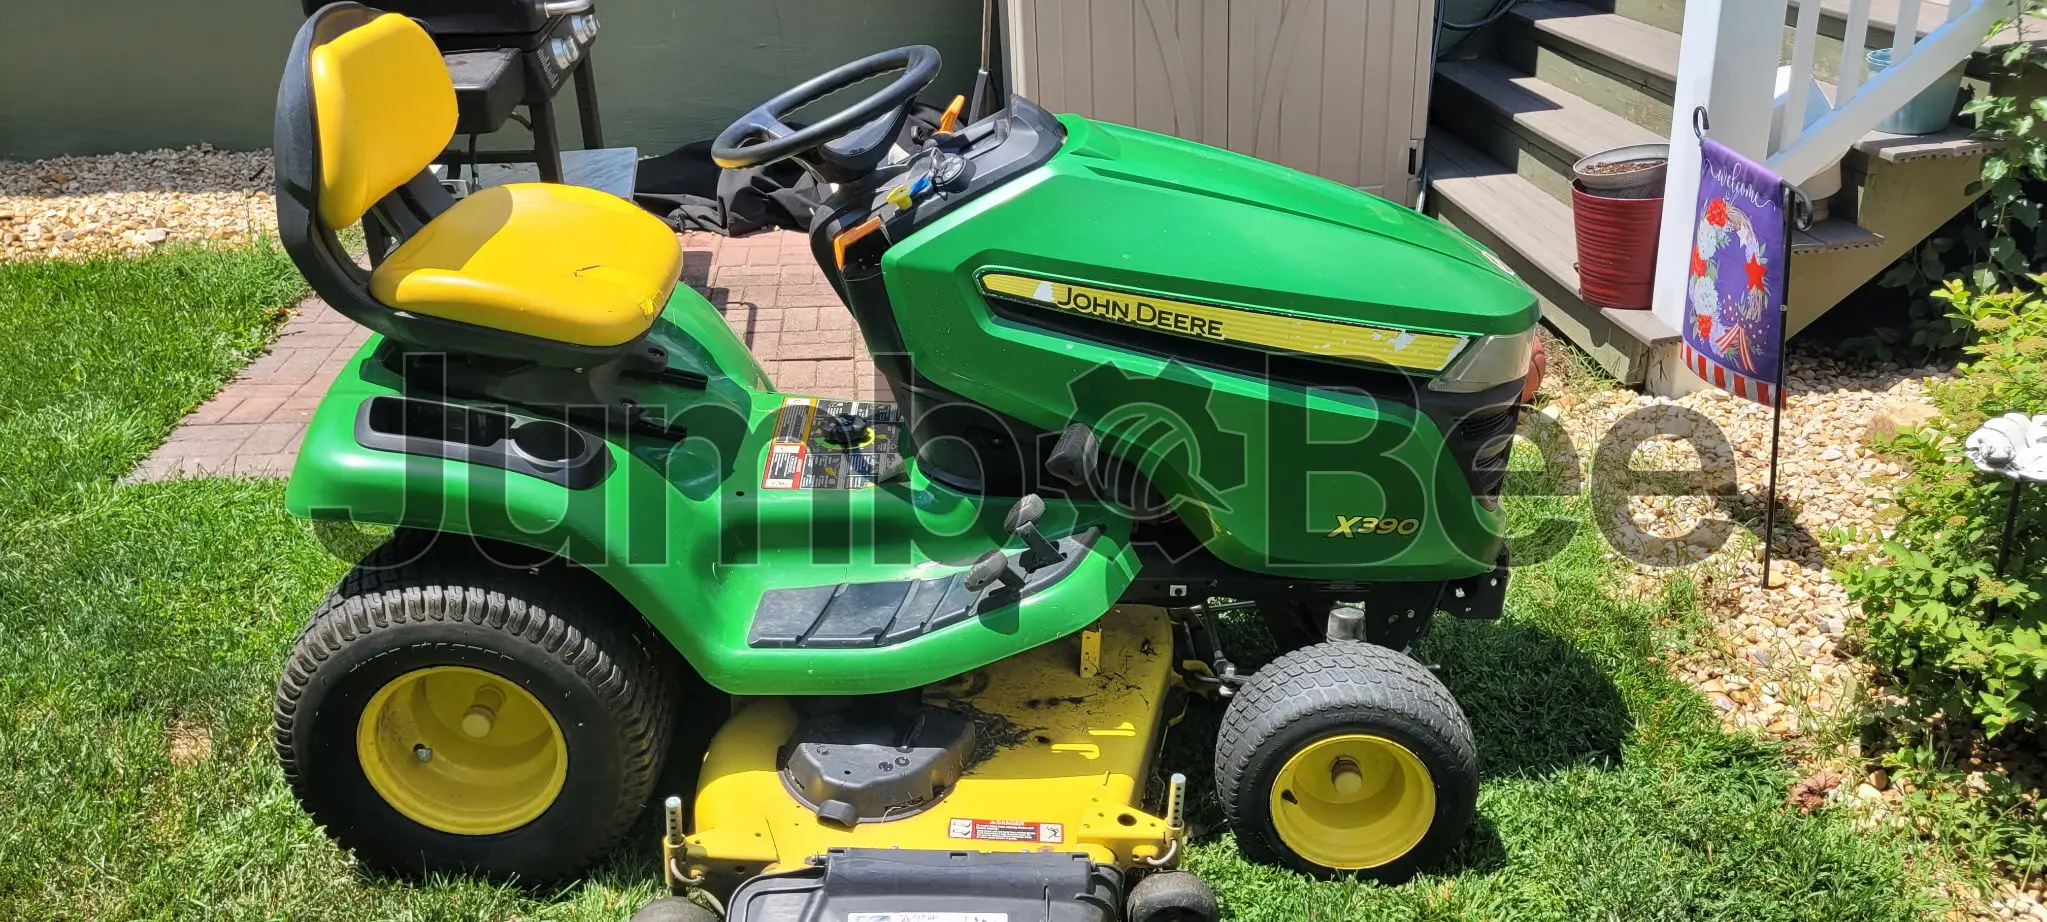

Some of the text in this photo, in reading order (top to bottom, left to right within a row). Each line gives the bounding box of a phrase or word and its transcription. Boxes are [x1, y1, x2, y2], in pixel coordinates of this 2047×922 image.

[1705, 158, 1776, 212] welcome
[1058, 287, 1223, 337] JOHN DEERE
[1326, 515, 1420, 538] X390
